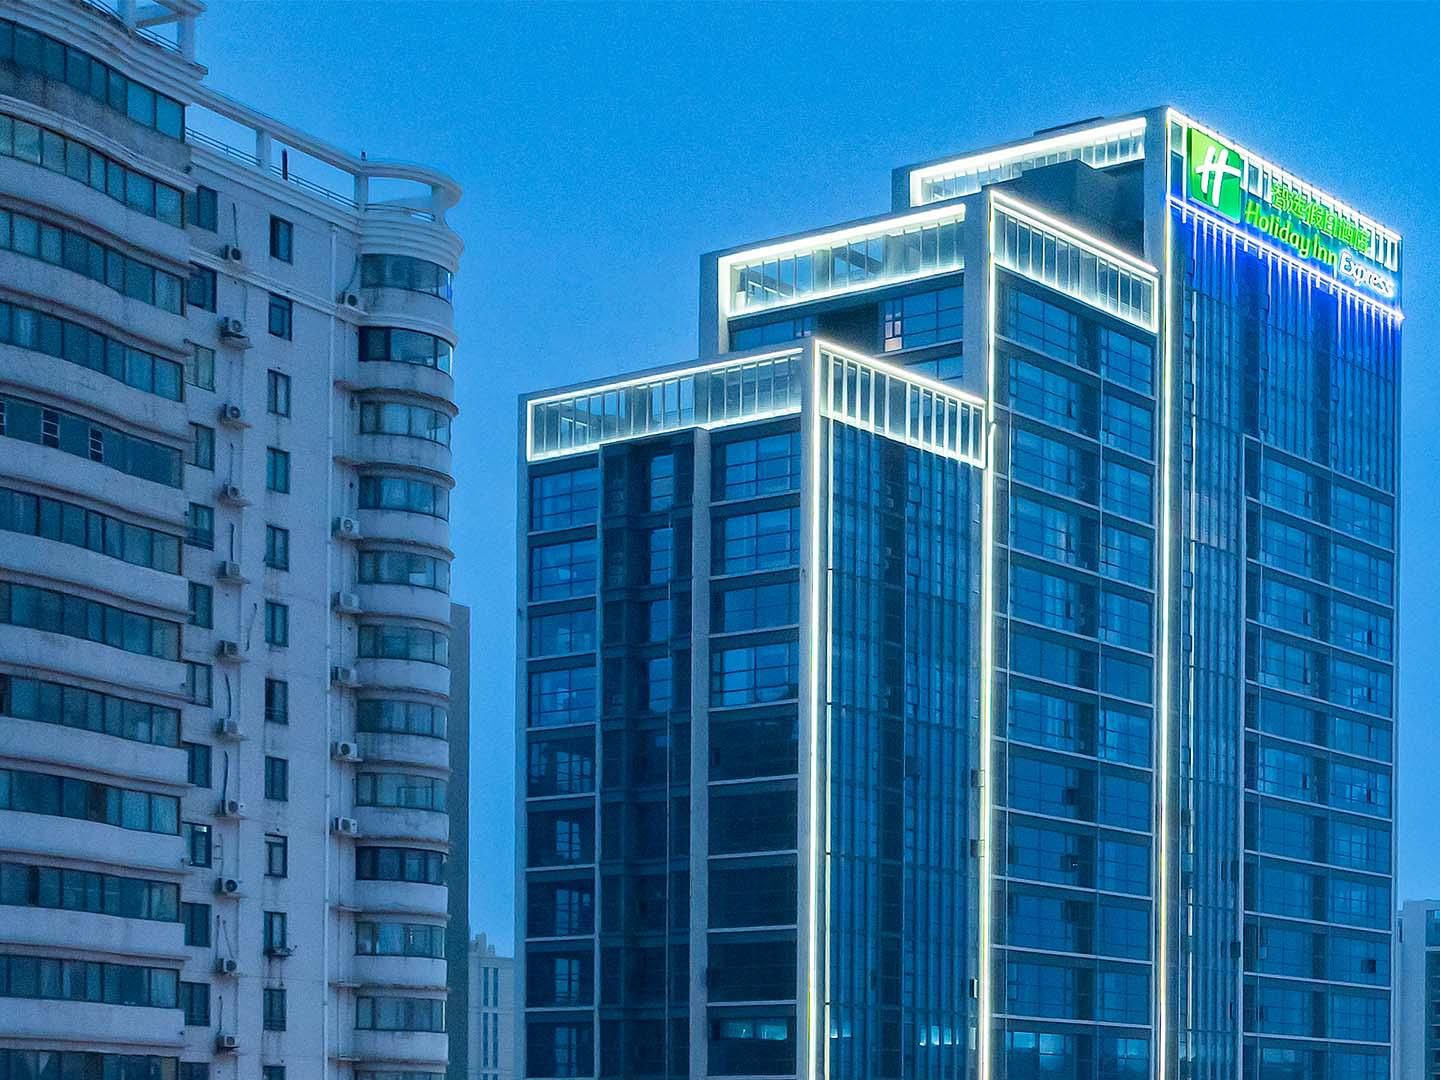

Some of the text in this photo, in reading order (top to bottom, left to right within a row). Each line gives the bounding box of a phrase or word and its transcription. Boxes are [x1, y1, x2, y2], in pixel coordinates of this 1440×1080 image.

[1245, 200, 1393, 298] Holiday Inn Express
[1271, 182, 1370, 254] 智选假日酒店
